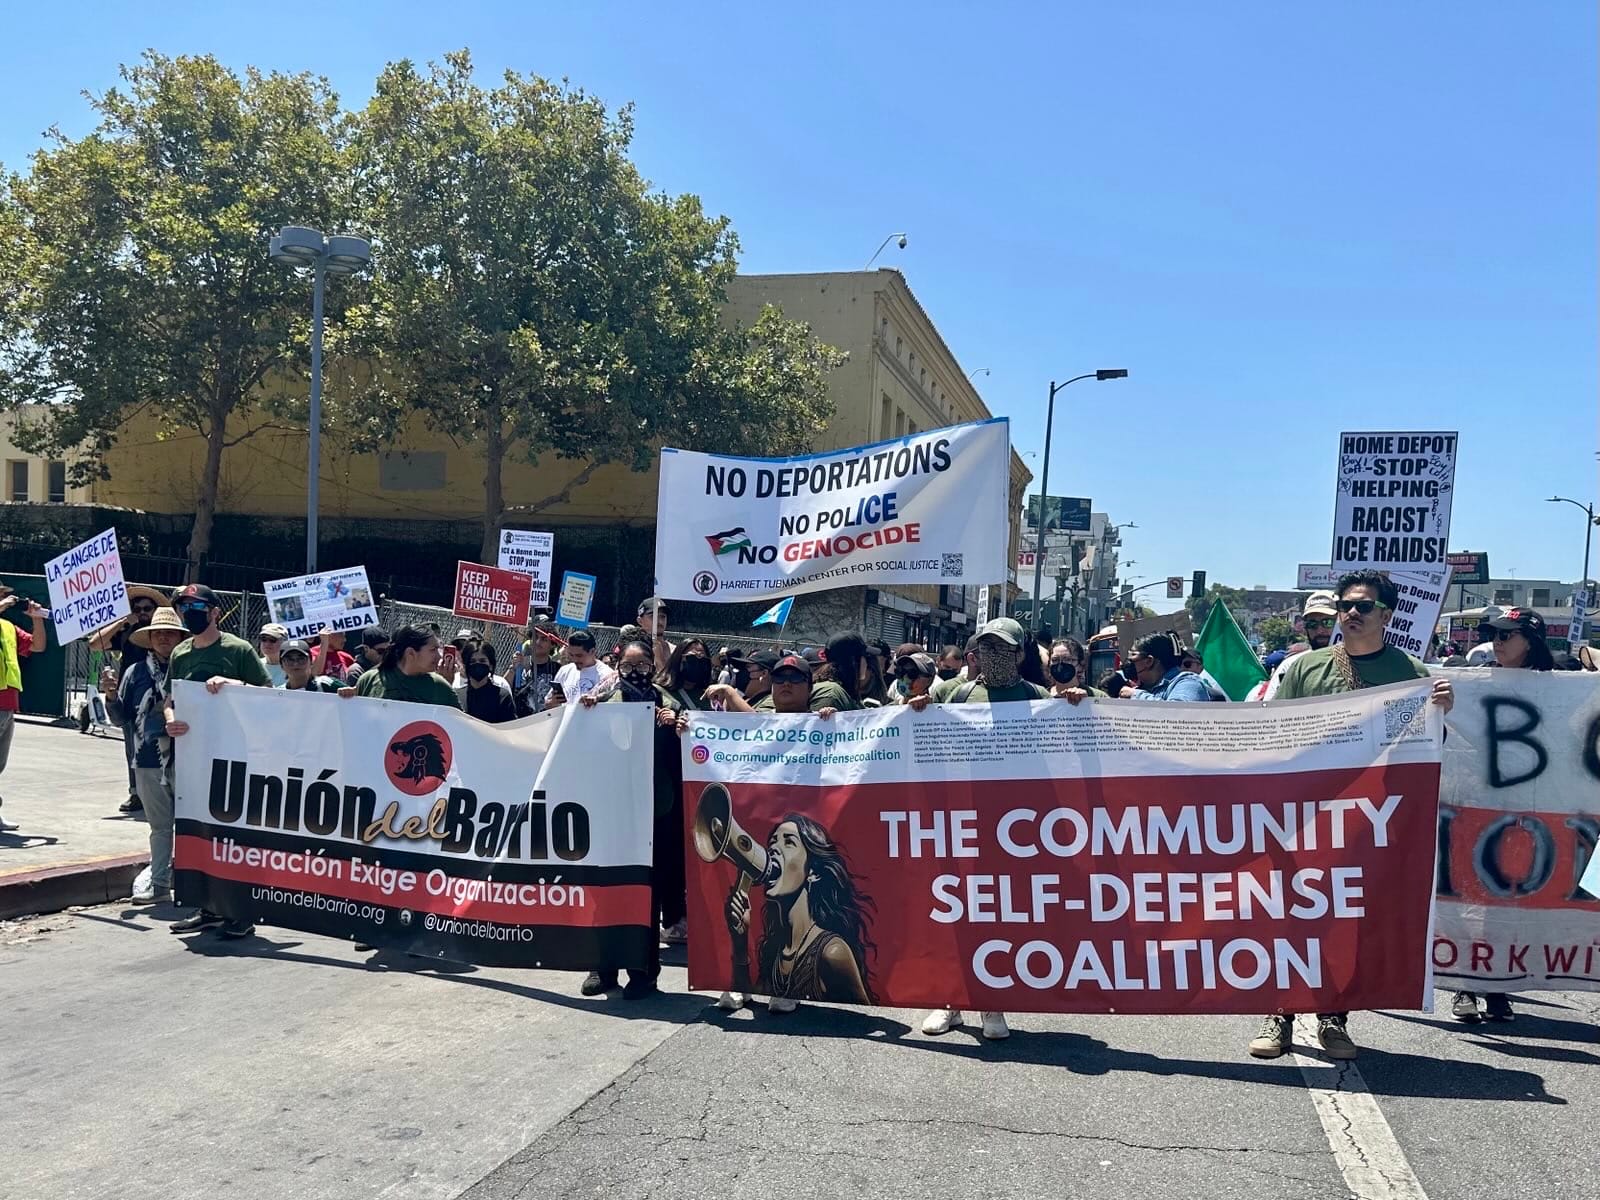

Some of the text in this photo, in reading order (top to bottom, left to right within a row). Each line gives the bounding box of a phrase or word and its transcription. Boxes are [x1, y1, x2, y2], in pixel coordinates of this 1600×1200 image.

[1343, 435, 1455, 454] HOME DEPOT
[706, 439, 951, 498] NO DEPORTATIONS
[1352, 480, 1439, 497] HELPING
[780, 492, 898, 537] NO POLICE
[1352, 506, 1429, 533] RACIST
[738, 522, 920, 565] NO GENOCIDE
[1336, 536, 1446, 563] ICE RAIDS!
[47, 532, 116, 583] LA SANGRE DE
[509, 556, 540, 567] STOP your
[63, 563, 107, 600] INDIO
[271, 581, 298, 592] HANDS
[462, 570, 490, 586] KEEP
[720, 559, 939, 590] HARRIET TUBMAN CENTER FOR SOCIAL JUSTICE
[54, 581, 125, 625] QUE TRAIGO ES
[460, 595, 517, 617] TOGETHER!
[461, 582, 509, 603] FAMILIES
[1409, 585, 1441, 603] Depot
[79, 604, 117, 632] MEJOR
[1397, 598, 1418, 615] our
[288, 621, 327, 639] LMER
[1391, 615, 1414, 633] war
[1384, 628, 1422, 652] ngeles
[694, 723, 900, 747] CSDCLA2025@gmail.com
[713, 749, 901, 764] @communityselfdefensecoalition
[208, 758, 590, 861] Unión del Barrio
[880, 794, 1403, 858] THE COMMUNITY
[212, 837, 585, 907] Liberación Exige Organización
[929, 866, 1366, 924] SELF-DEFENSE
[252, 887, 534, 943] uniondelbarrio.org @uniondelbarrio
[972, 937, 1323, 991] COALITION
[1432, 938, 1600, 975] ORK WI
